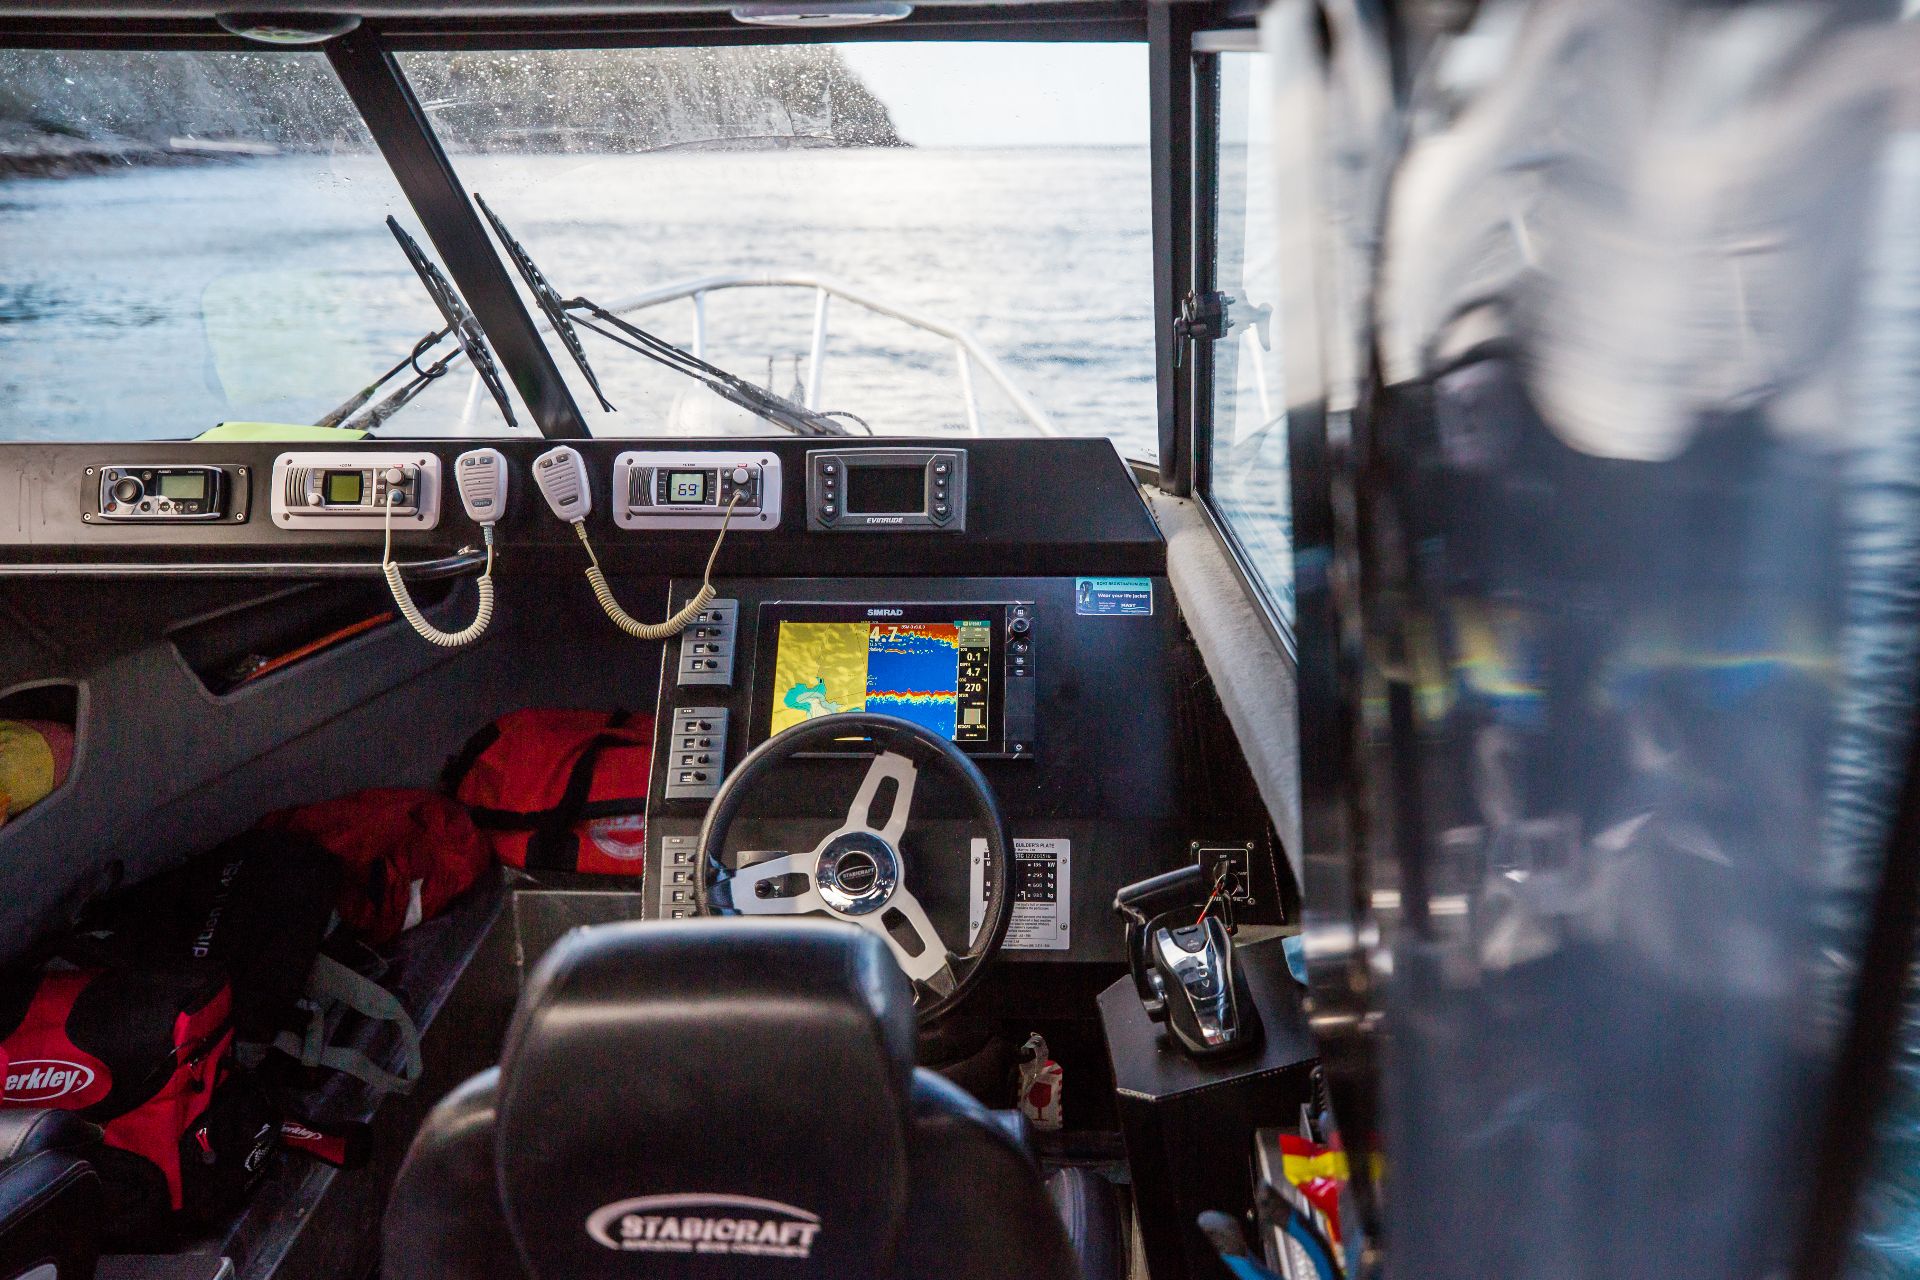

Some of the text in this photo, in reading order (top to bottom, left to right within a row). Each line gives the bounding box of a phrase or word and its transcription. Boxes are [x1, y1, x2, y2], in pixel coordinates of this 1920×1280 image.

[678, 483, 697, 497] 69
[870, 625, 898, 642] 4.7
[967, 652, 981, 661] 0.1
[966, 667, 981, 677] 4.7
[964, 683, 981, 692] 270
[619, 1213, 822, 1246] STABICRAFT
